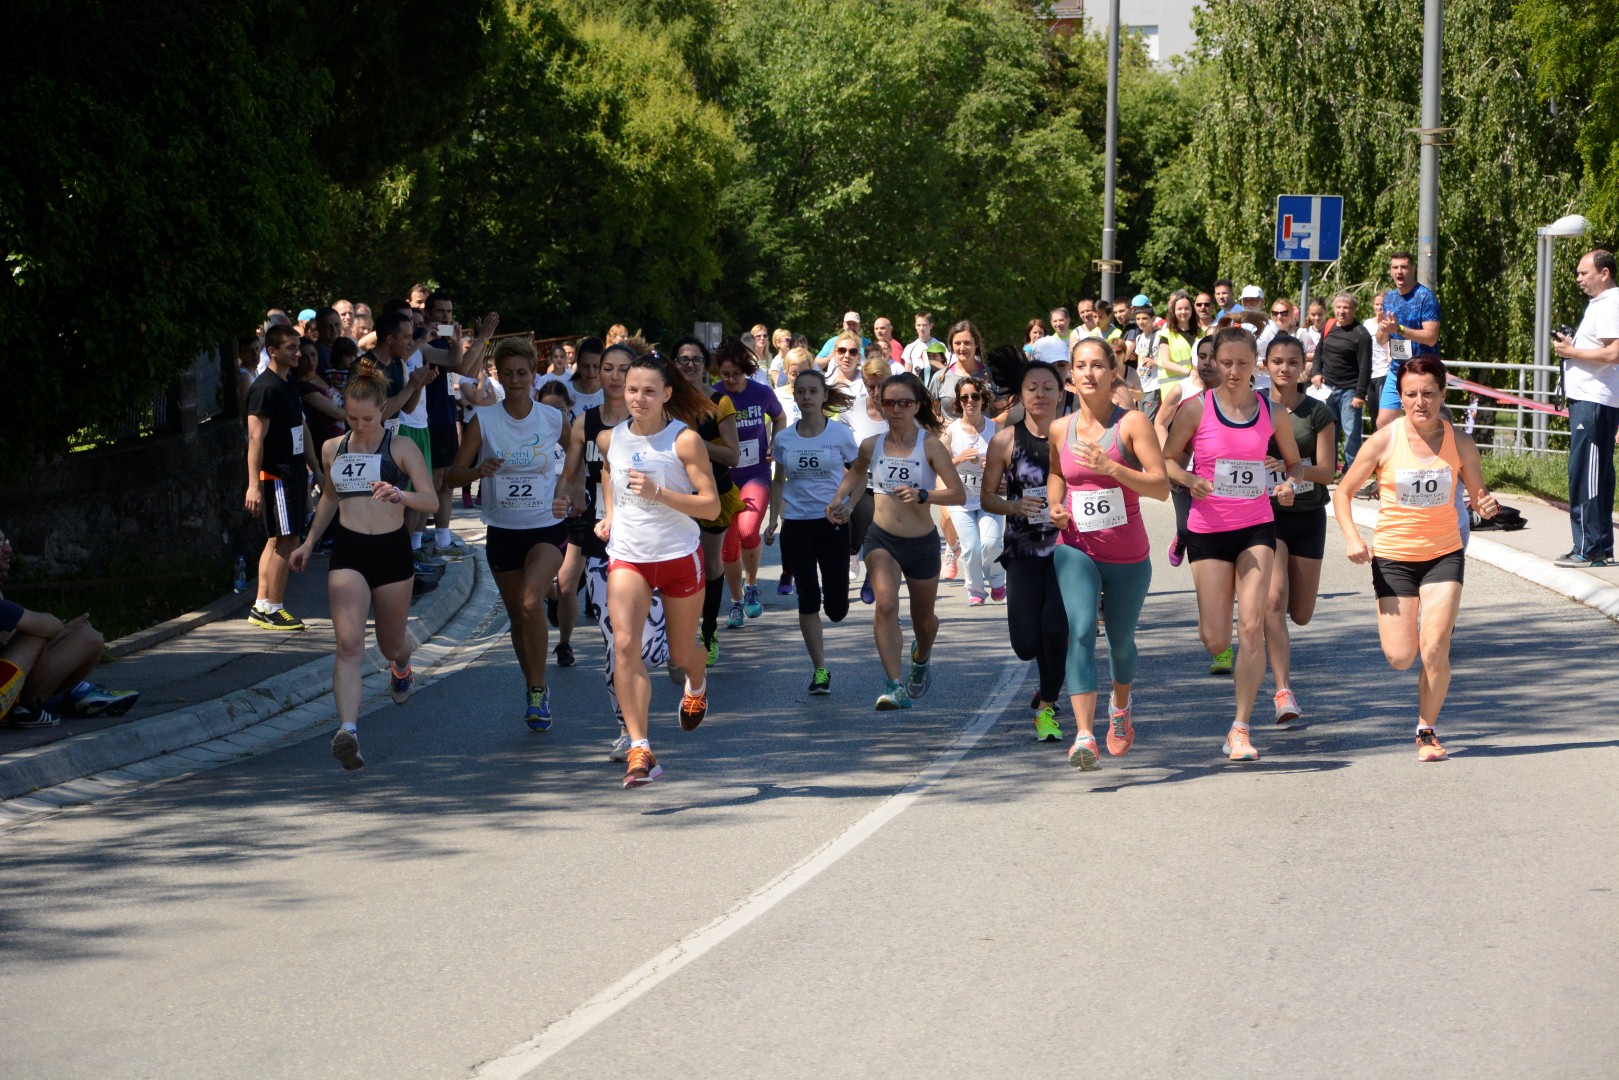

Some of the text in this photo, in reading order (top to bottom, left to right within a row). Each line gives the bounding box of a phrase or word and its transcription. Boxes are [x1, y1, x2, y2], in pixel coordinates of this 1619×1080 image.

[799, 456, 819, 468] 56
[342, 463, 366, 477] 47
[888, 466, 909, 480] 78
[1229, 470, 1254, 484] 19
[508, 484, 533, 497] 22
[1411, 479, 1438, 493] 10
[1084, 500, 1111, 516] 86
